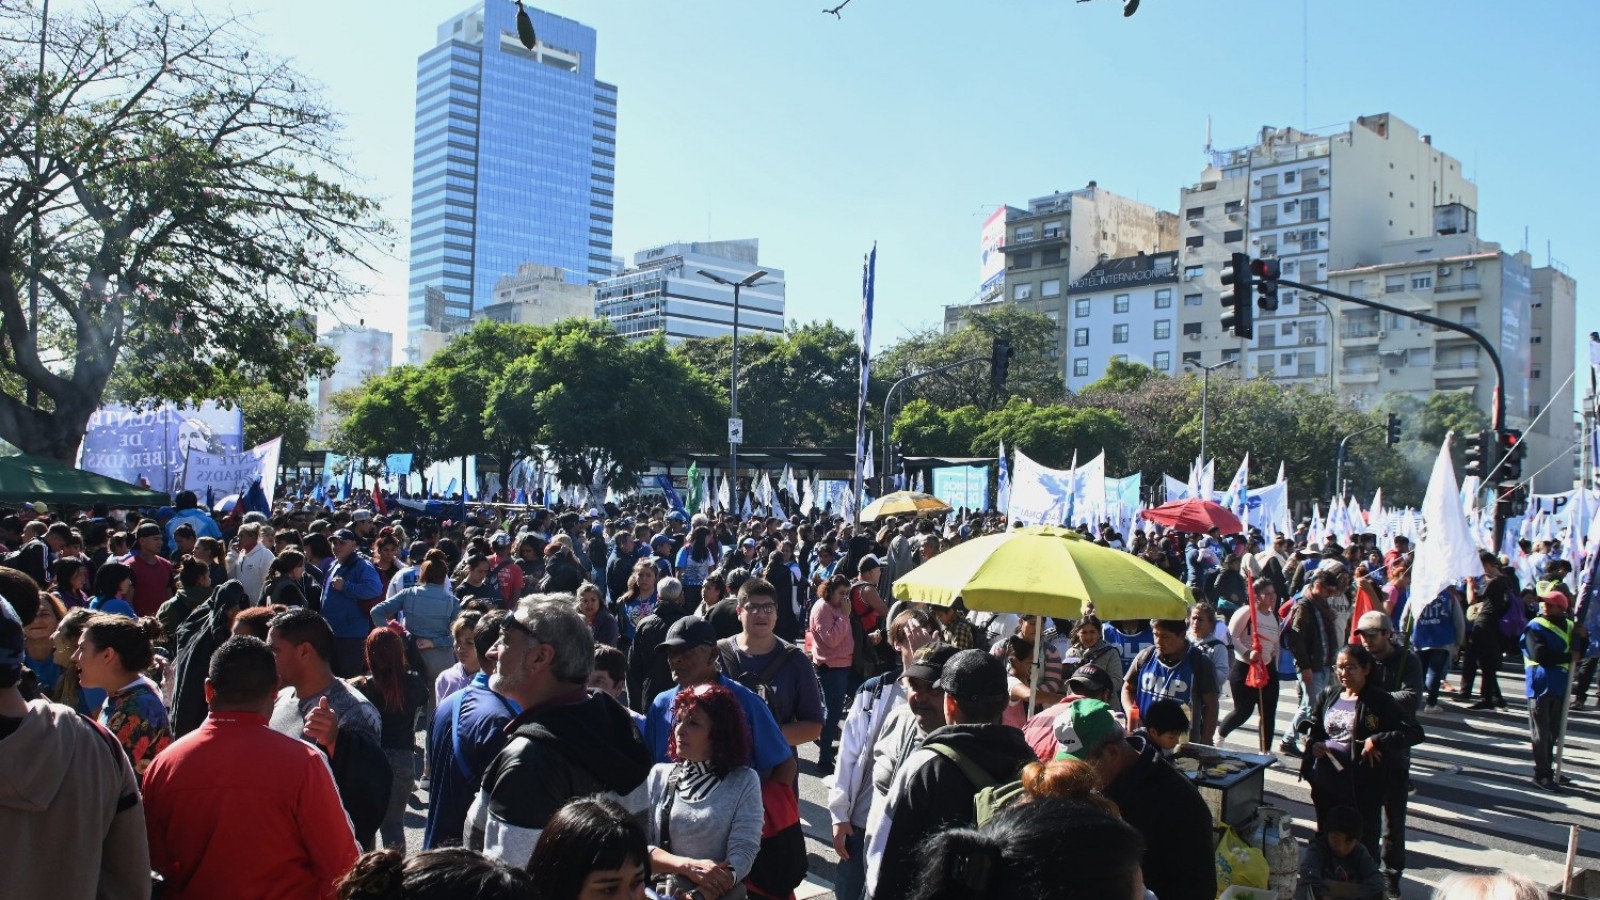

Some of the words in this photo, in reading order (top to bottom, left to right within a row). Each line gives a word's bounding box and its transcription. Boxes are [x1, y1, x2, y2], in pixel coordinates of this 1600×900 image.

[1069, 278, 1098, 289] HOTEL
[1100, 268, 1169, 285] INTERNACIONAL
[1531, 496, 1568, 515] LP
[1141, 672, 1188, 699] OLP
